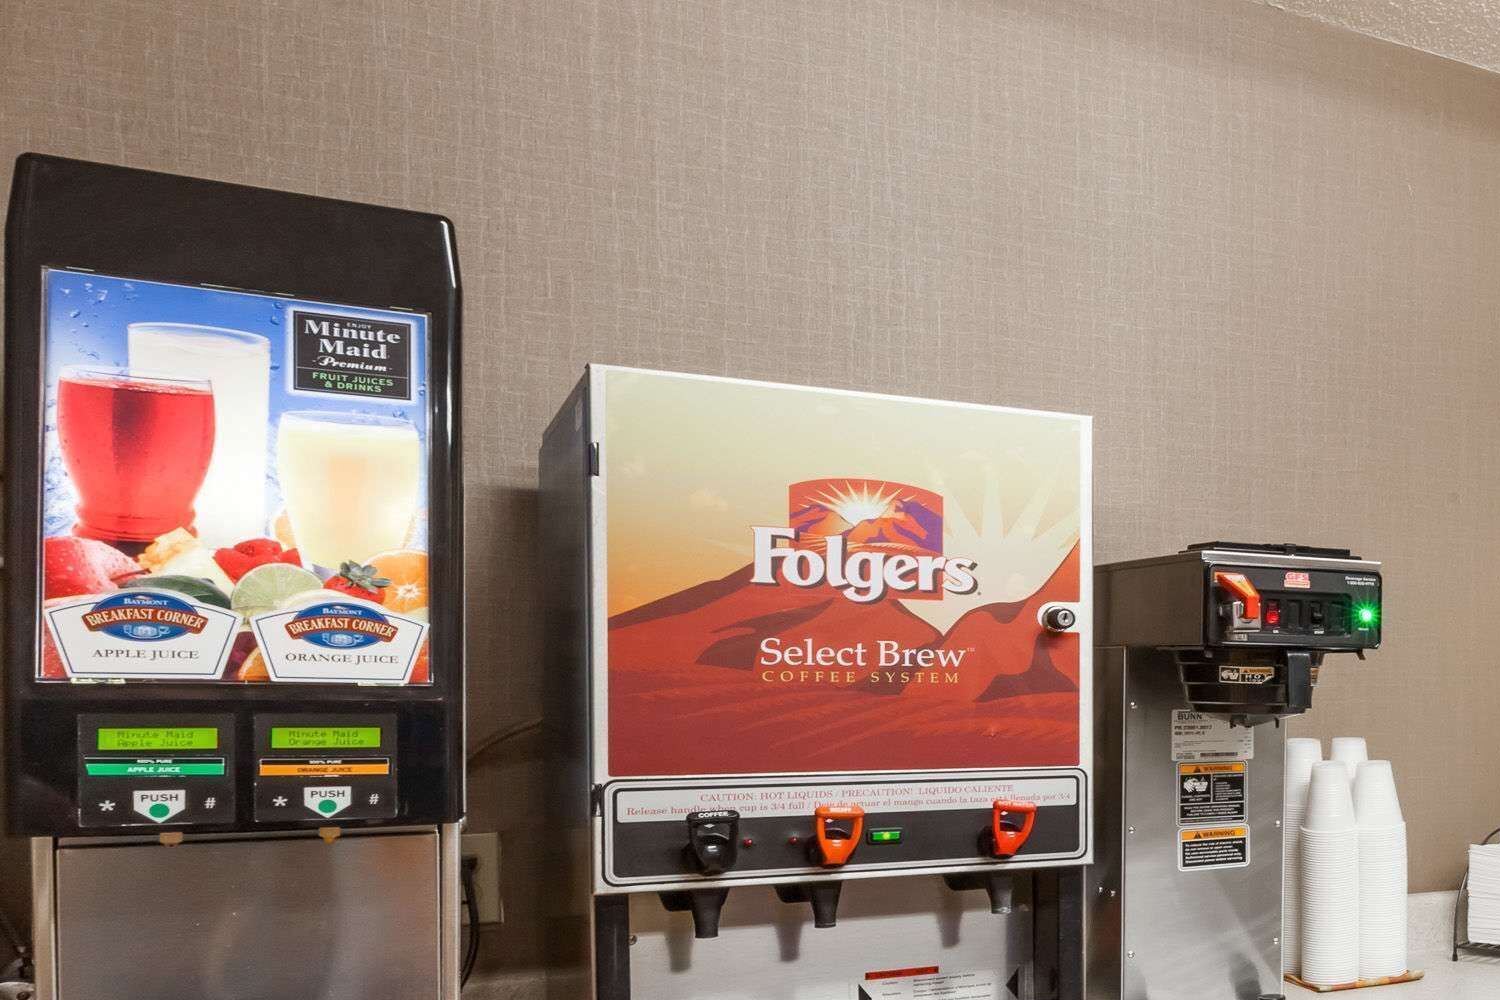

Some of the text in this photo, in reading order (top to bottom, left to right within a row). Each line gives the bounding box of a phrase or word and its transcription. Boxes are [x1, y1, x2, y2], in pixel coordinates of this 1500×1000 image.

[304, 319, 401, 344] Minute
[319, 338, 388, 360] Maid
[316, 355, 388, 372] Premium
[312, 371, 394, 387] FRUIT JUICES
[324, 380, 382, 393] & DRINKS
[750, 526, 978, 605] Folgers
[123, 597, 169, 606] BAYMONT
[322, 607, 363, 616] BAYMONT
[85, 608, 204, 629] BREAKFAST CORNER
[288, 617, 397, 637] BREAKFAST CORNER
[92, 649, 200, 661] APPLE JUICE
[285, 652, 399, 666] ORANGE JUICE
[759, 637, 967, 669] Select Brew
[761, 670, 960, 685] COFFEE SYSTEM
[116, 731, 194, 740] Minute Maid
[288, 729, 359, 739] Minute Maid
[116, 738, 194, 748] Apple Juice
[288, 737, 365, 747] Orange Juice
[140, 793, 179, 803] PUSH
[310, 789, 346, 799] PUSH
[760, 791, 785, 801] HOT
[786, 789, 833, 801] LIQUIDS
[963, 783, 1014, 794] CALIENTE
[627, 806, 668, 816] Release
[739, 804, 757, 814] cup
[759, 802, 768, 811] is
[770, 801, 786, 811] 3/4
[788, 800, 805, 811] full
[925, 796, 958, 806] cuando
[697, 810, 729, 819] COFFEE
[1202, 829, 1236, 838] WARNING
